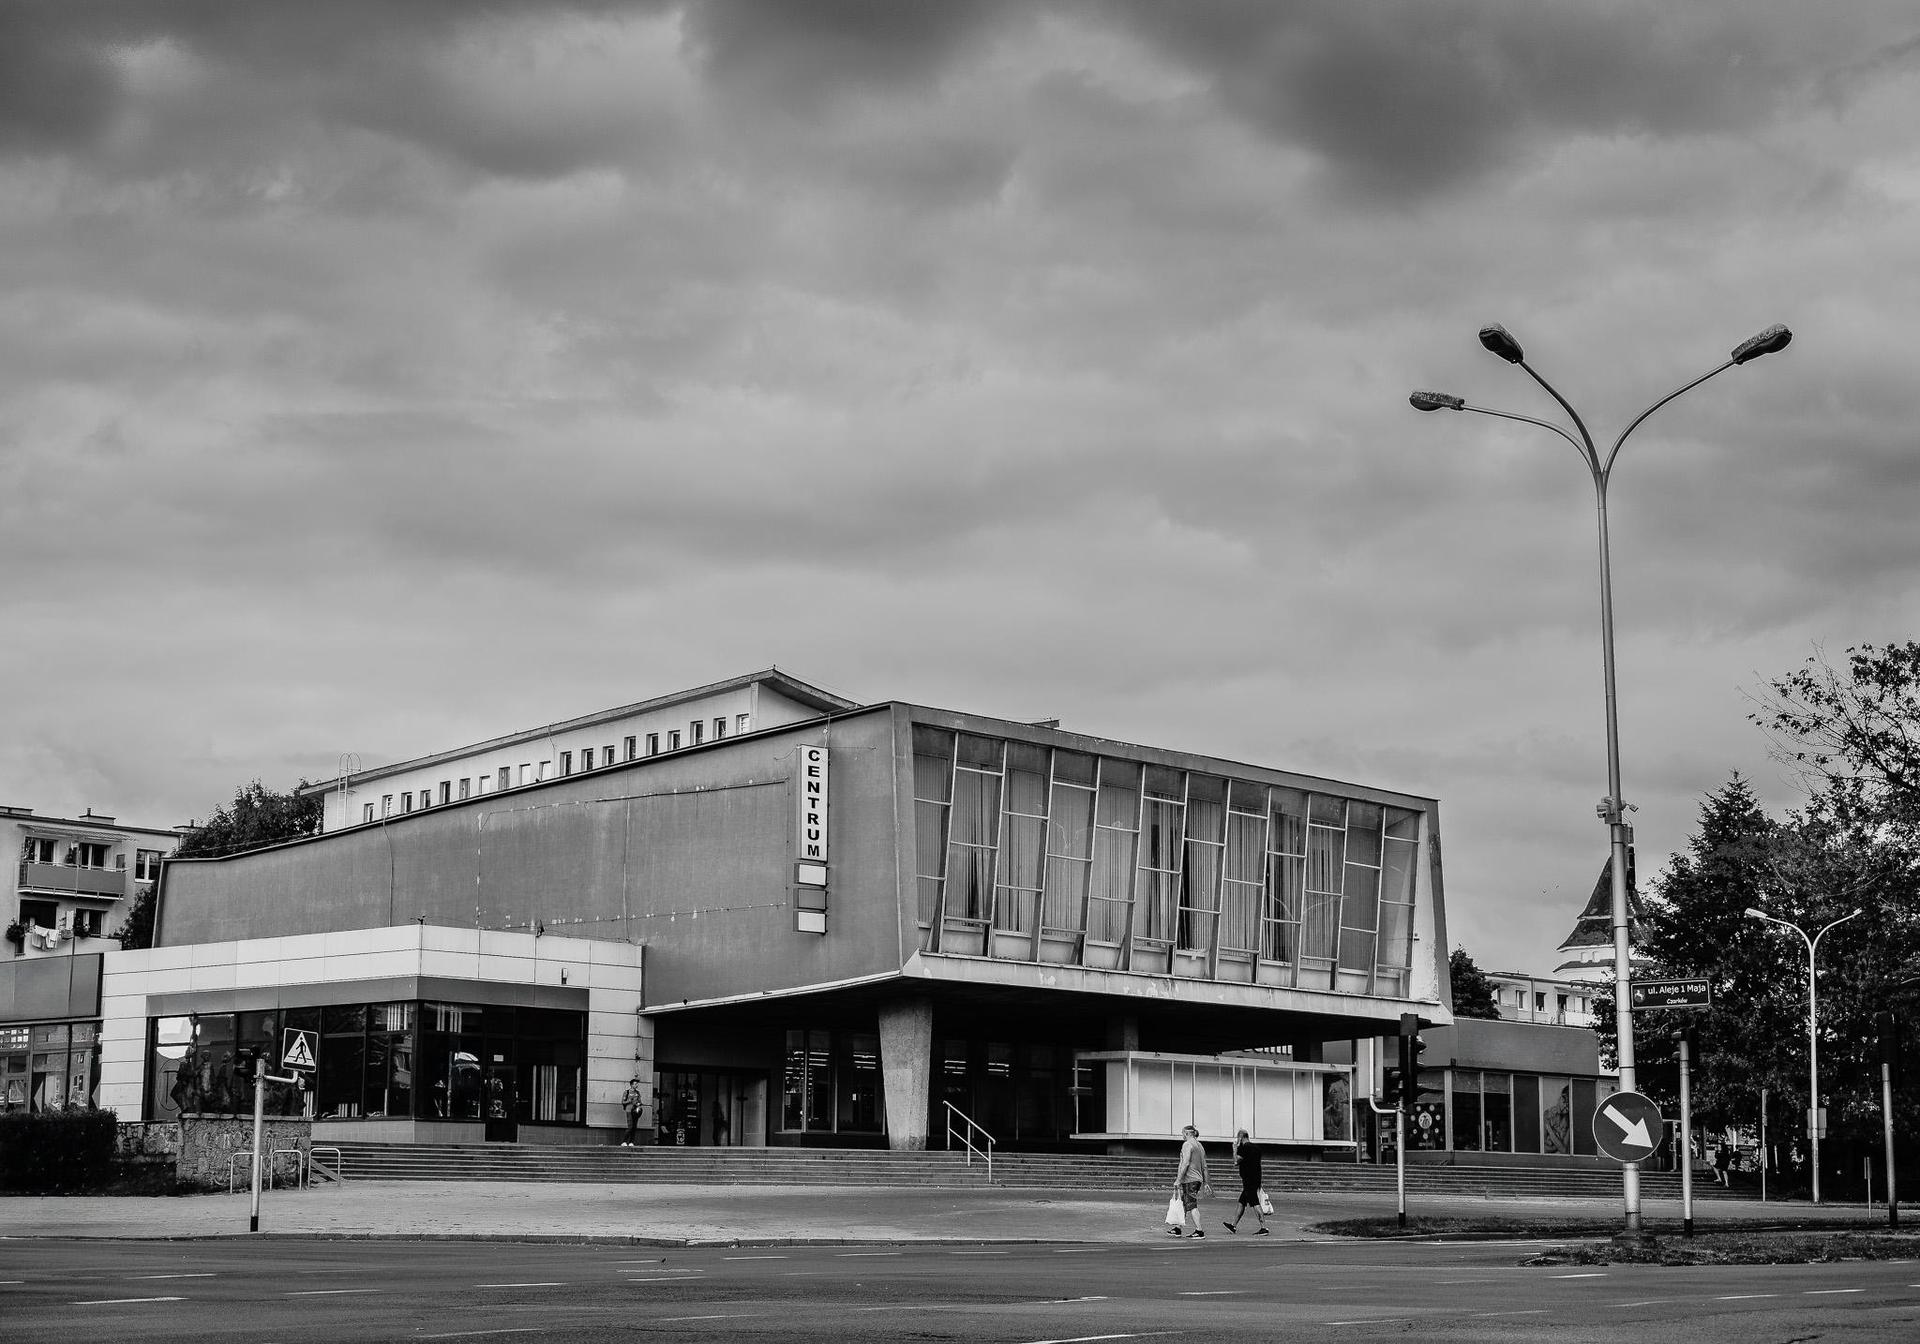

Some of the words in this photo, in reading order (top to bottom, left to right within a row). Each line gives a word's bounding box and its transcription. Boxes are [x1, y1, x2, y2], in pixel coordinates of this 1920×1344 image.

[808, 749, 820, 857] CENTRUM
[1647, 986, 1658, 995] ul.
[1659, 985, 1680, 995] Aleje
[1681, 985, 1686, 993] 1
[1687, 983, 1706, 994] Maja
